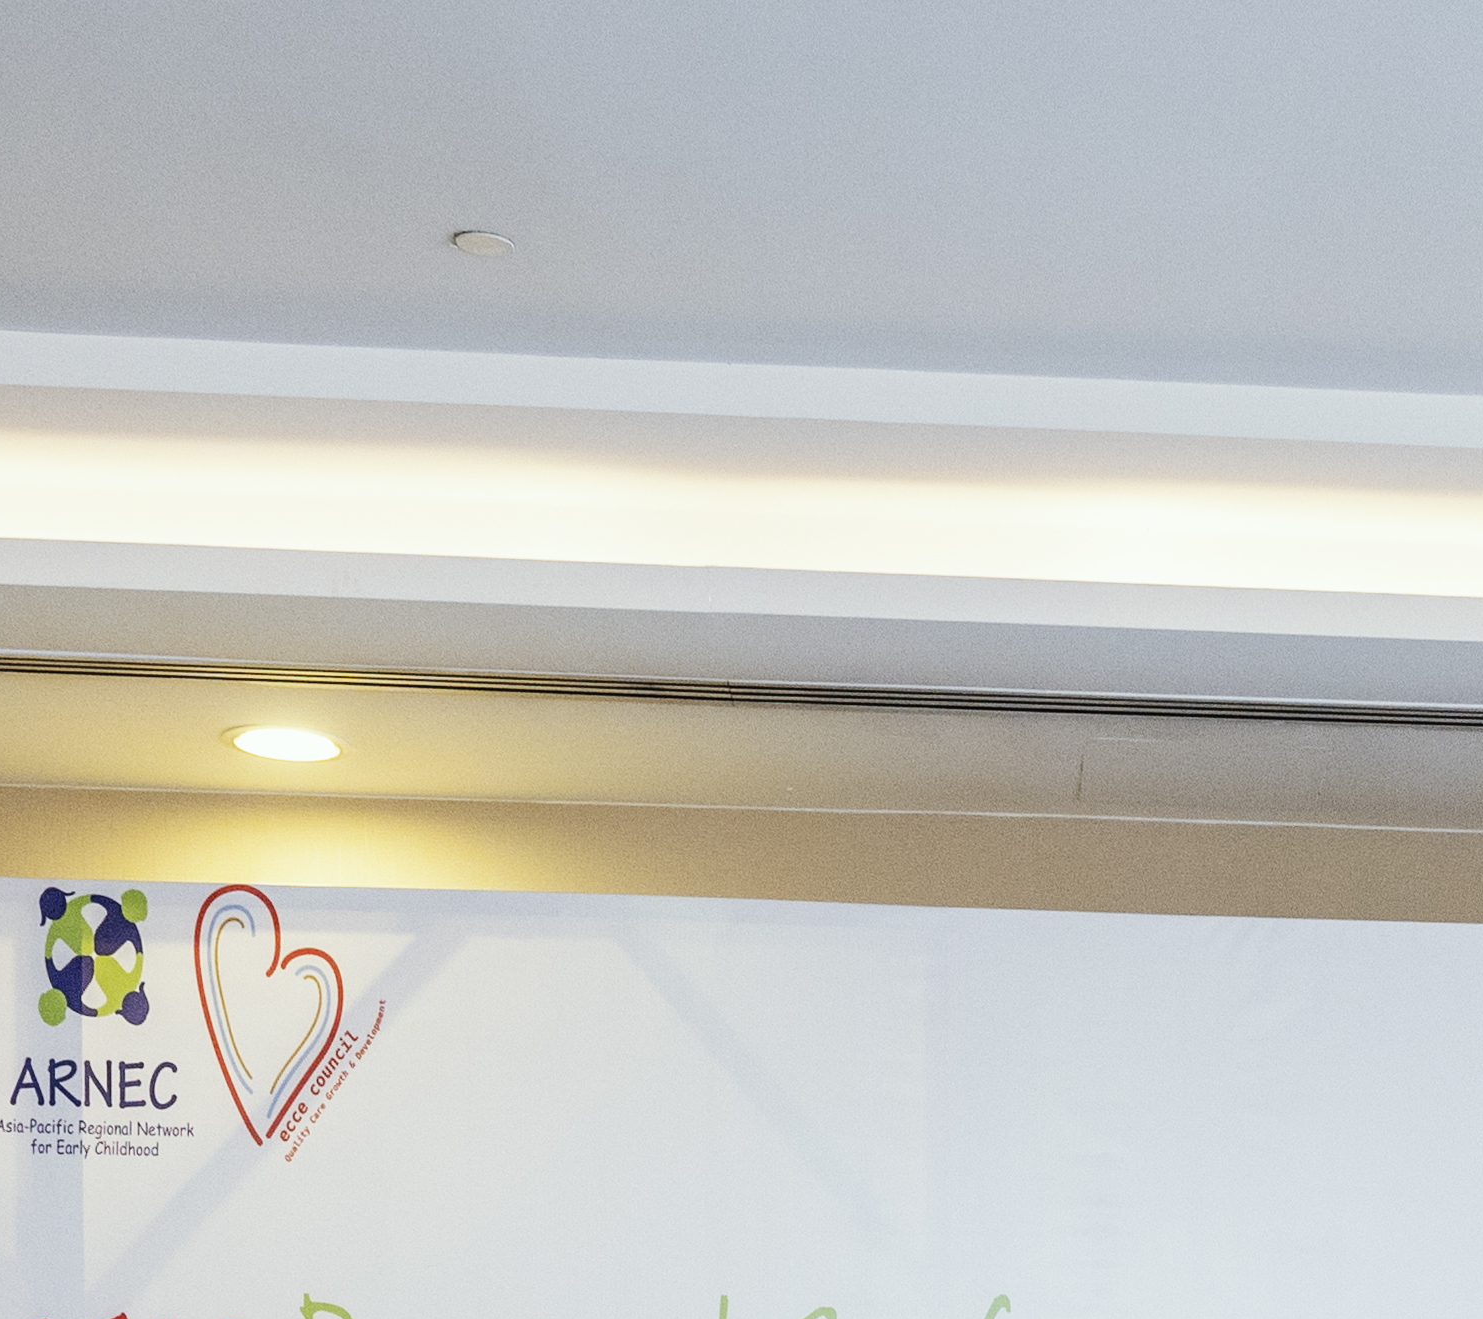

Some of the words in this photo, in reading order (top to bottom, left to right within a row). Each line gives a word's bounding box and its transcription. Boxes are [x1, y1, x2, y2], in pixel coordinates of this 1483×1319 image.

[9, 1057, 178, 1110] ARNEC
[279, 1102, 309, 1142] ecce
[310, 1030, 359, 1096] council
[284, 1126, 311, 1163] Quality
[309, 1102, 326, 1124] Care
[325, 1070, 349, 1101] Growth
[355, 998, 387, 1061] Development
[31, 1138, 52, 1155] for
[56, 1139, 91, 1159] Early
[94, 1141, 160, 1157] Childhood
[78, 1120, 132, 1139] Regional
[136, 1121, 195, 1137] Network
